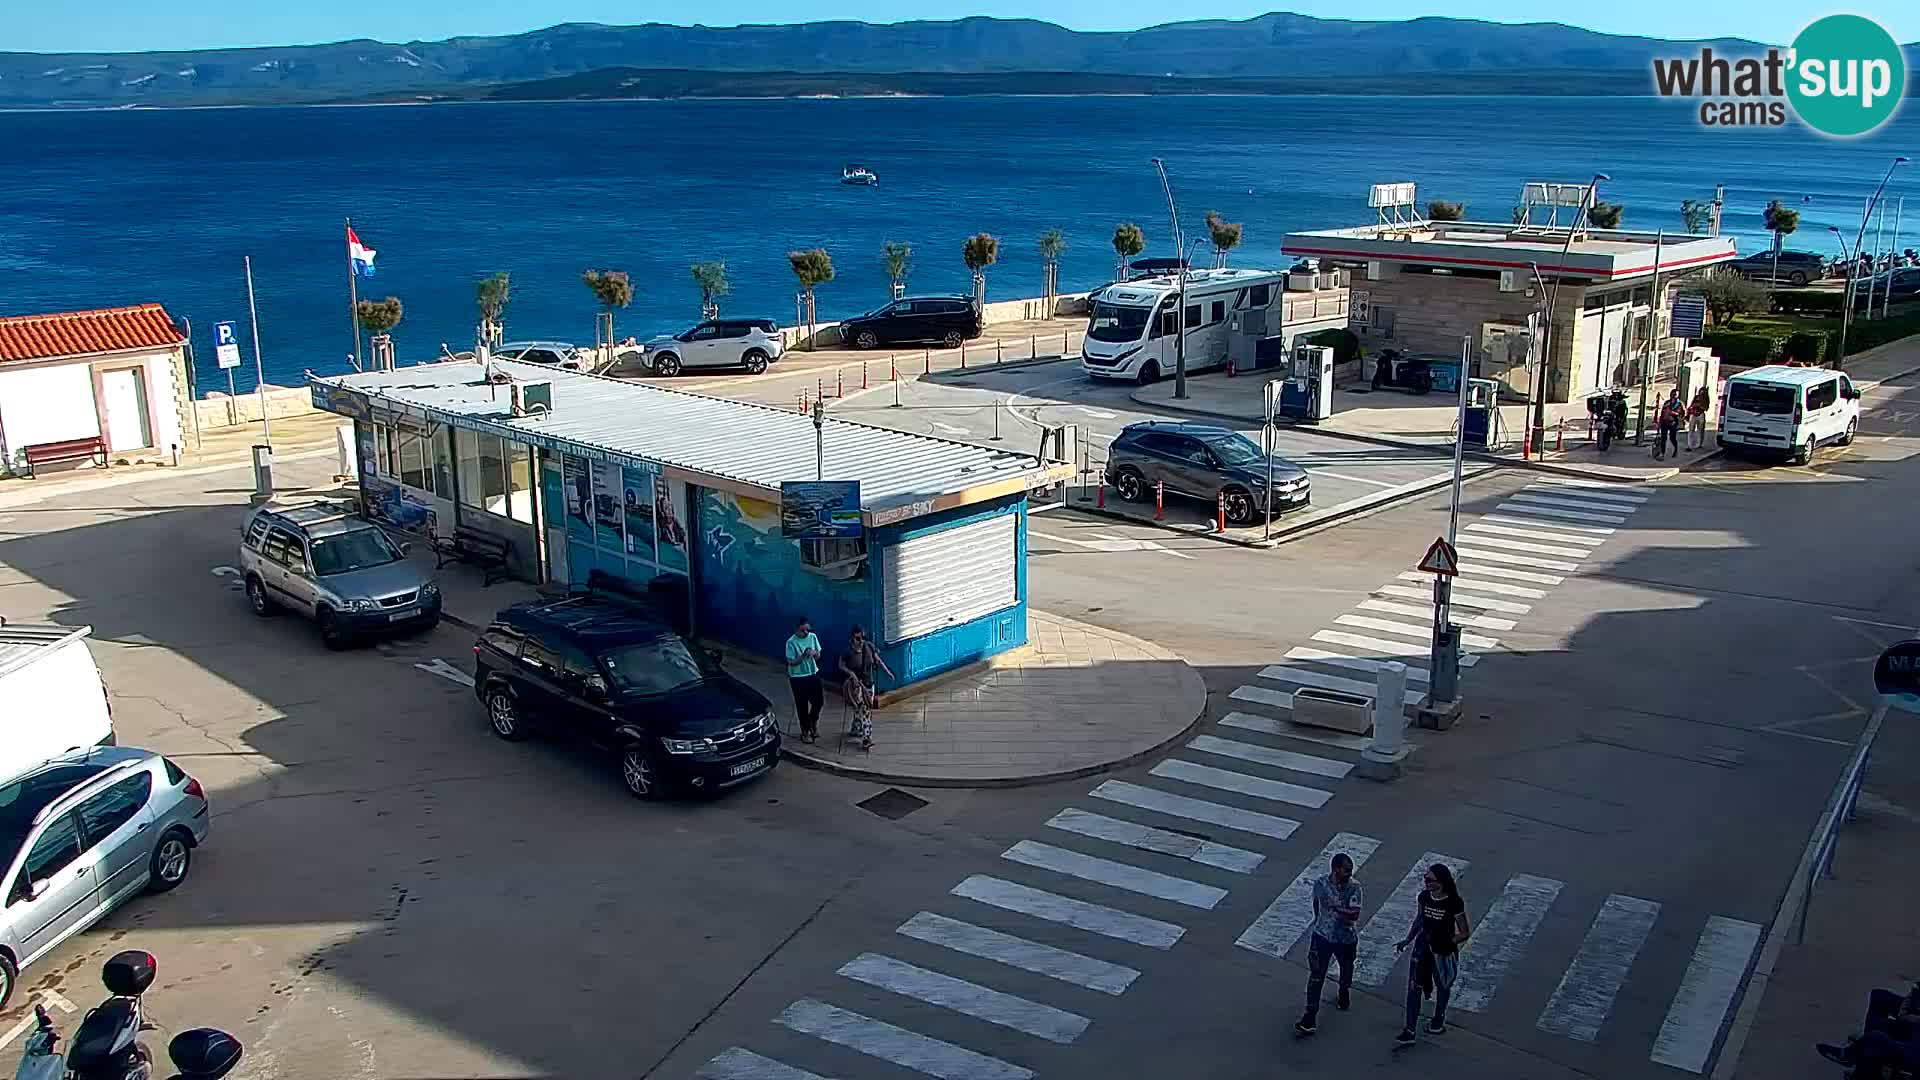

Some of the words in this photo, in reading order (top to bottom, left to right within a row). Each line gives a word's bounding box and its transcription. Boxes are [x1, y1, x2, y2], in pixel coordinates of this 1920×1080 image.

[218, 325, 232, 344] P
[556, 441, 572, 453] BUS
[572, 445, 604, 460] STATION
[606, 453, 631, 468] TICKET
[632, 459, 659, 473] OFFICE
